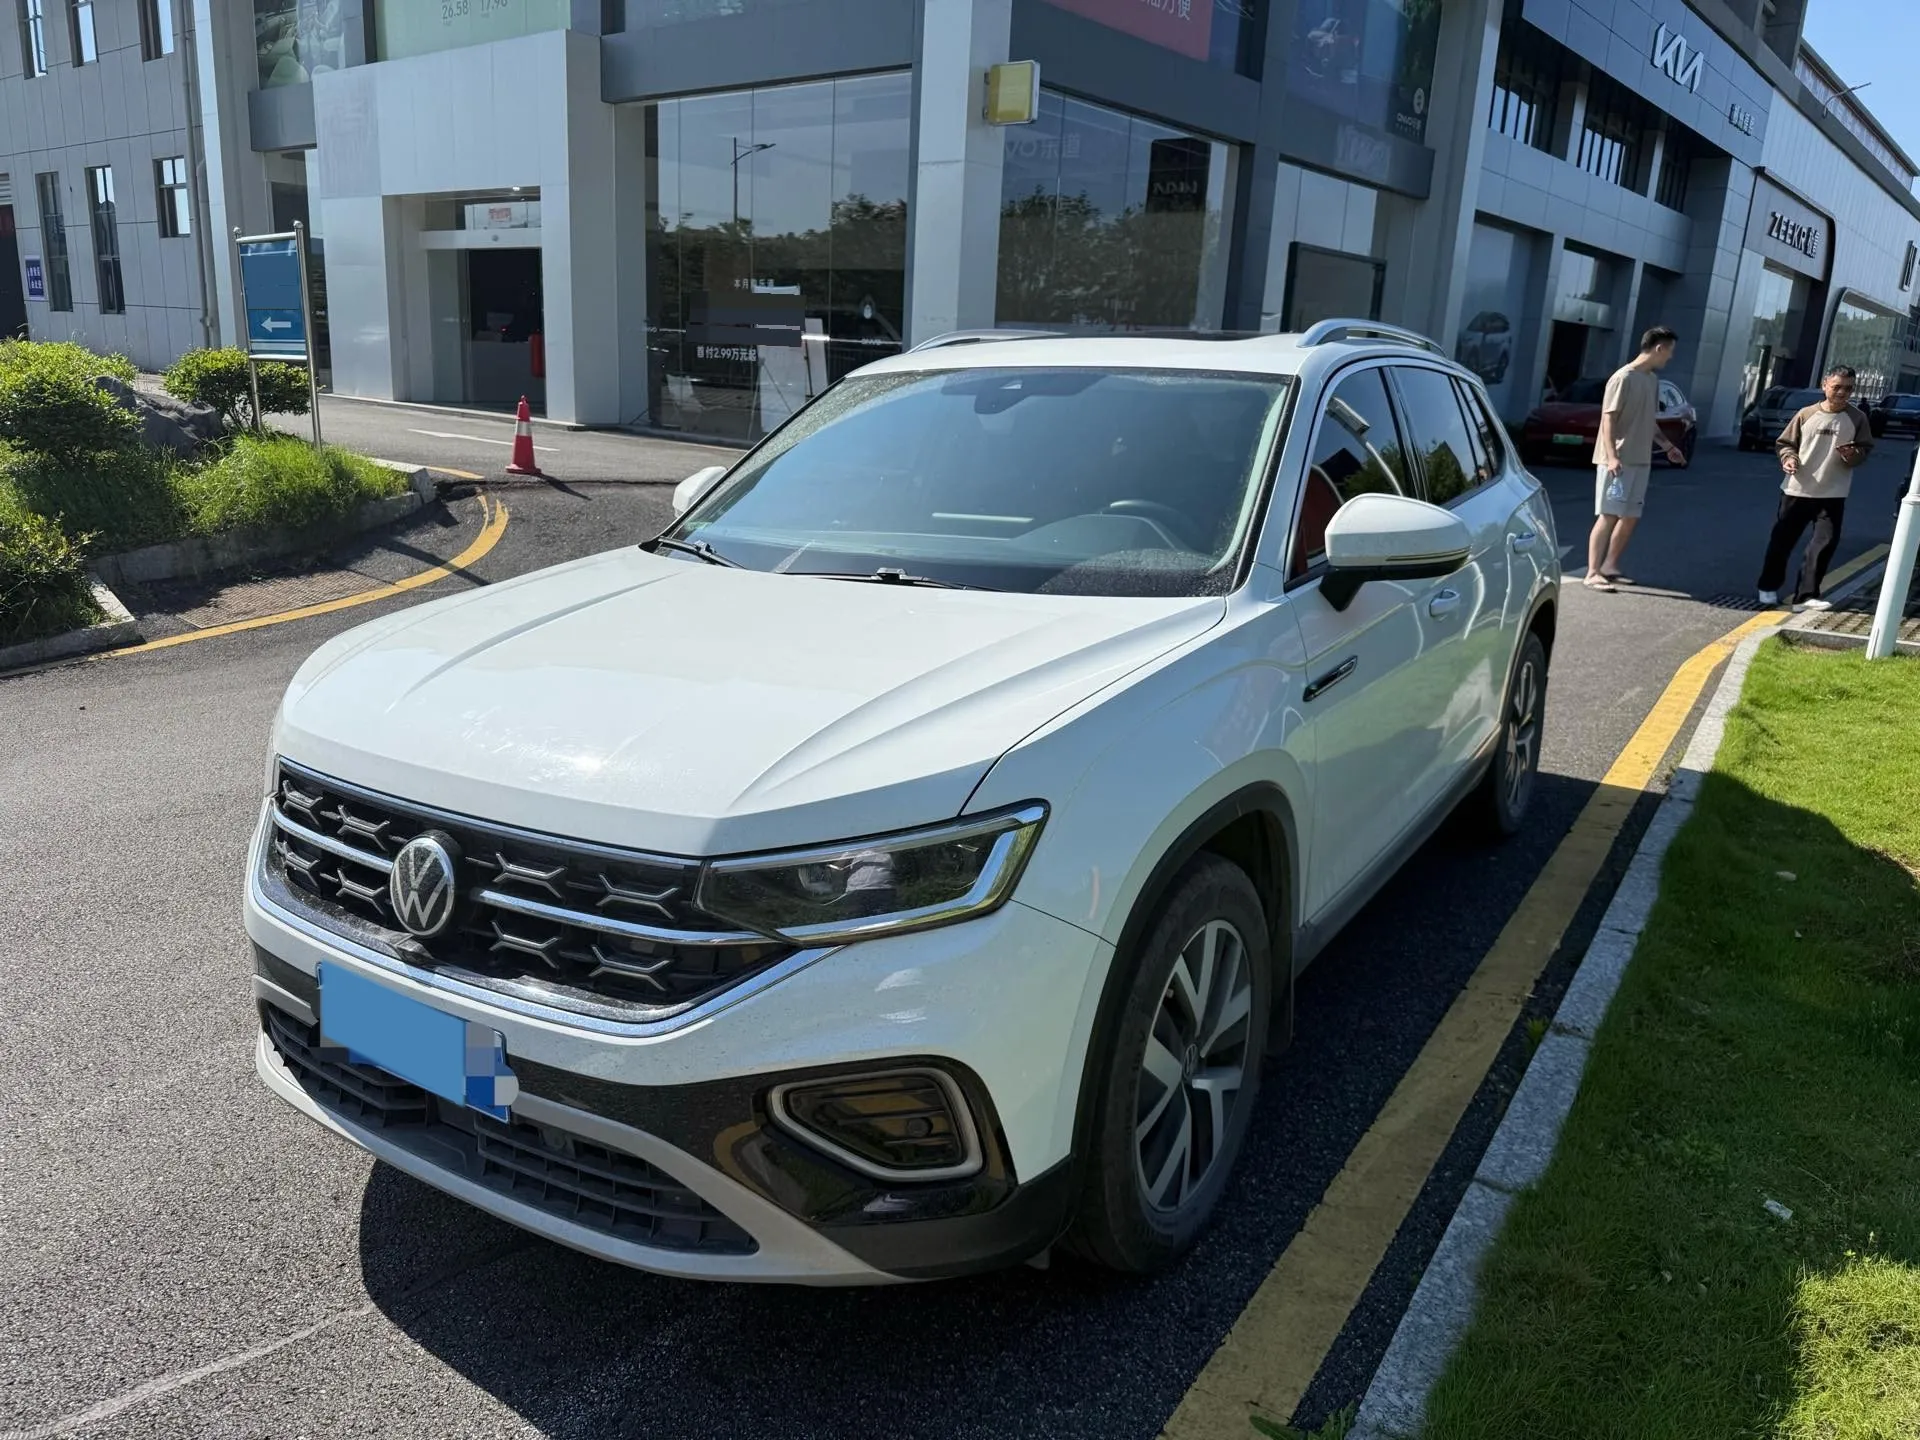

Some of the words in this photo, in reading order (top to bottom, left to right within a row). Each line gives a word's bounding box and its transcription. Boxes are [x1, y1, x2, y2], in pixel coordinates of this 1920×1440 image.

[442, 0, 469, 18] 26.58
[1651, 22, 1704, 92] KIA
[1769, 211, 1808, 254] ZEEKR
